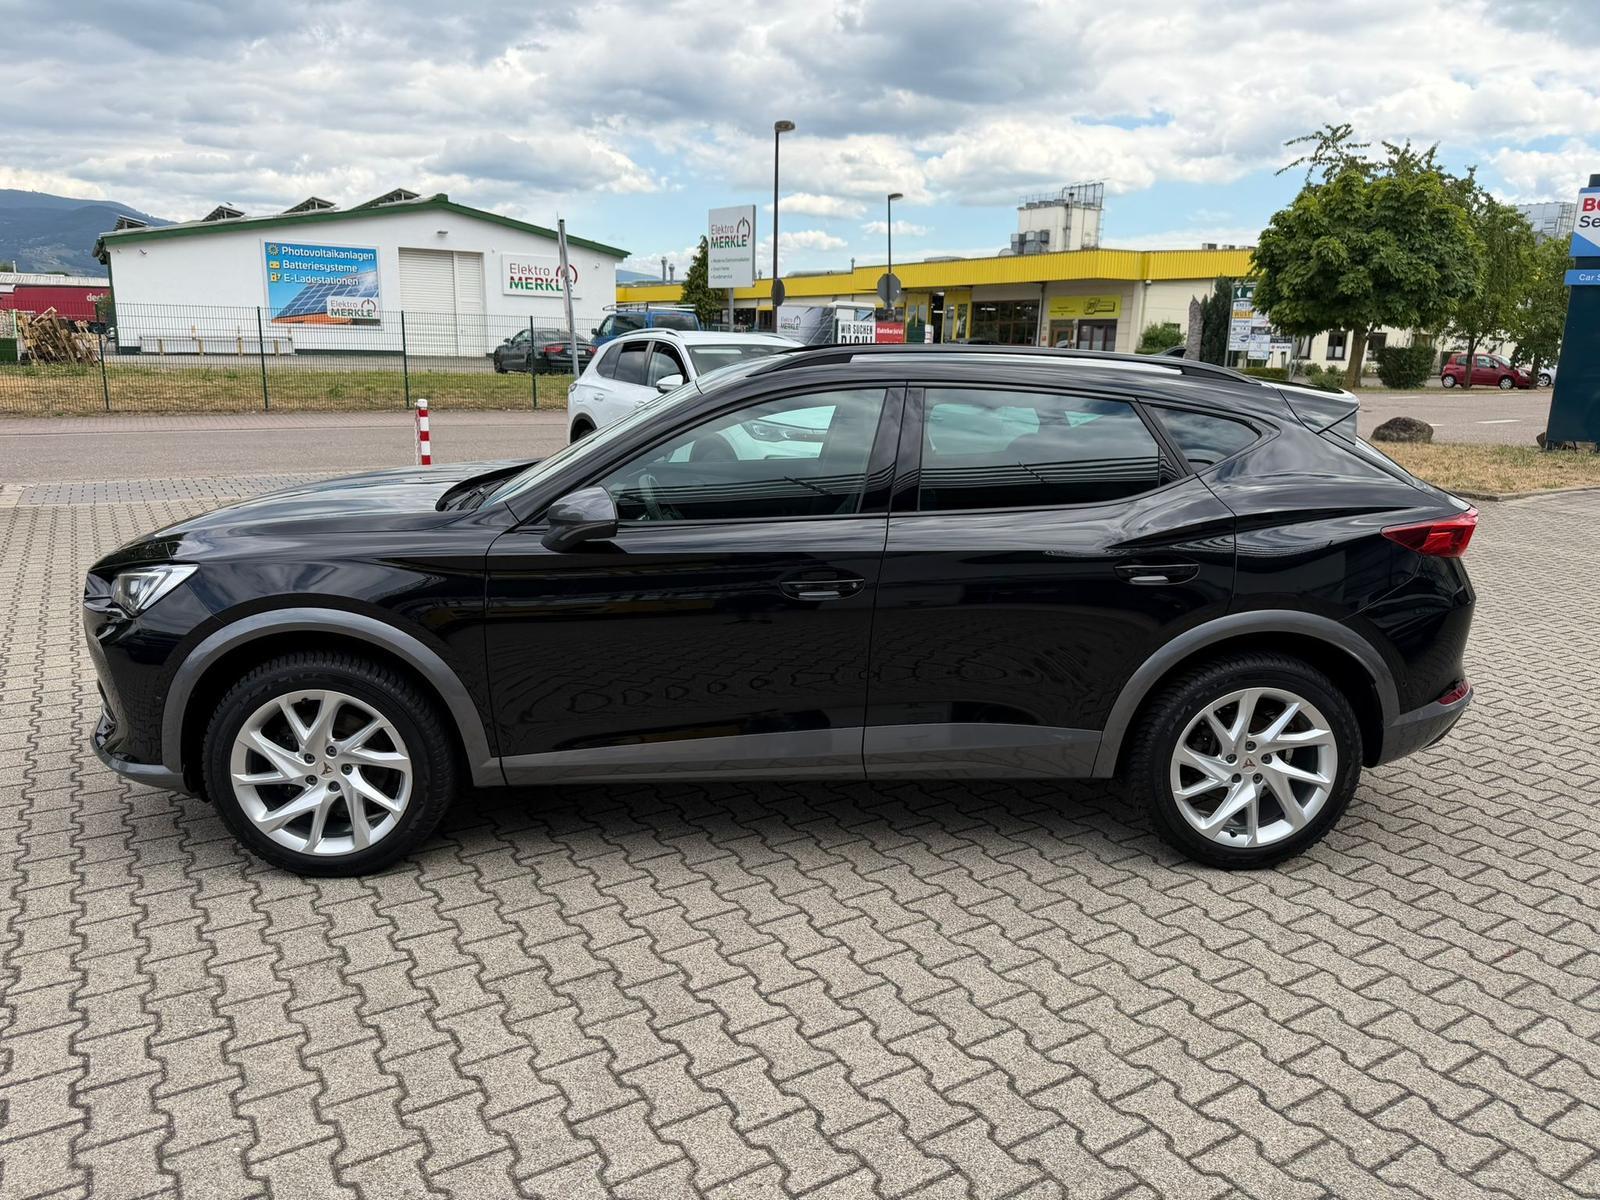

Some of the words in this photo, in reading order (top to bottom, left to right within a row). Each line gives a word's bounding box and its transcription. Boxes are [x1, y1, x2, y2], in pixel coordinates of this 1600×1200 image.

[1582, 197, 1600, 212] B
[711, 224, 735, 235] Elektro
[710, 234, 748, 249] MERKLE
[281, 246, 375, 261] Photovoltaikanlagen
[283, 260, 358, 273] Batteriesysteme
[509, 263, 550, 276] Elektro
[284, 273, 359, 285] E-Ladestationen
[1579, 273, 1595, 281] Car
[509, 276, 573, 292] MERKL
[331, 308, 373, 317] MERKLE
[840, 323, 851, 334] WIR
[853, 324, 873, 335] SUCHEN
